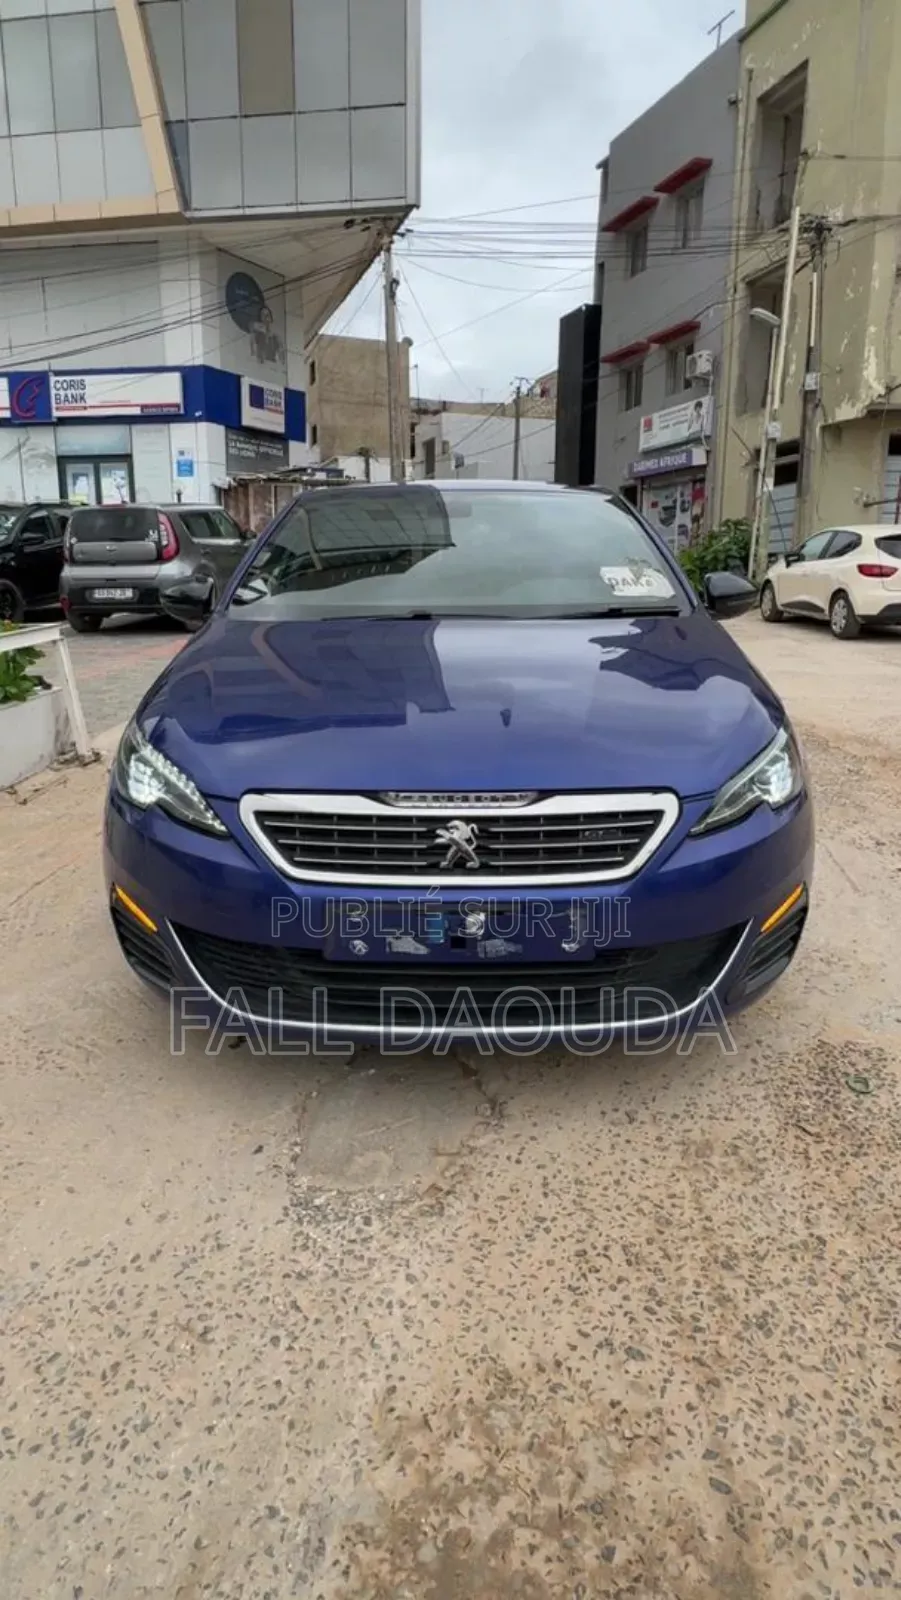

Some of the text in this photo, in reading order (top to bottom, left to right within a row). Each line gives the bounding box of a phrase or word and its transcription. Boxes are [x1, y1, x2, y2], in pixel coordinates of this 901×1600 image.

[53, 378, 87, 392] CORIS
[54, 392, 87, 405] BANK
[660, 452, 687, 468] AFRIQUE
